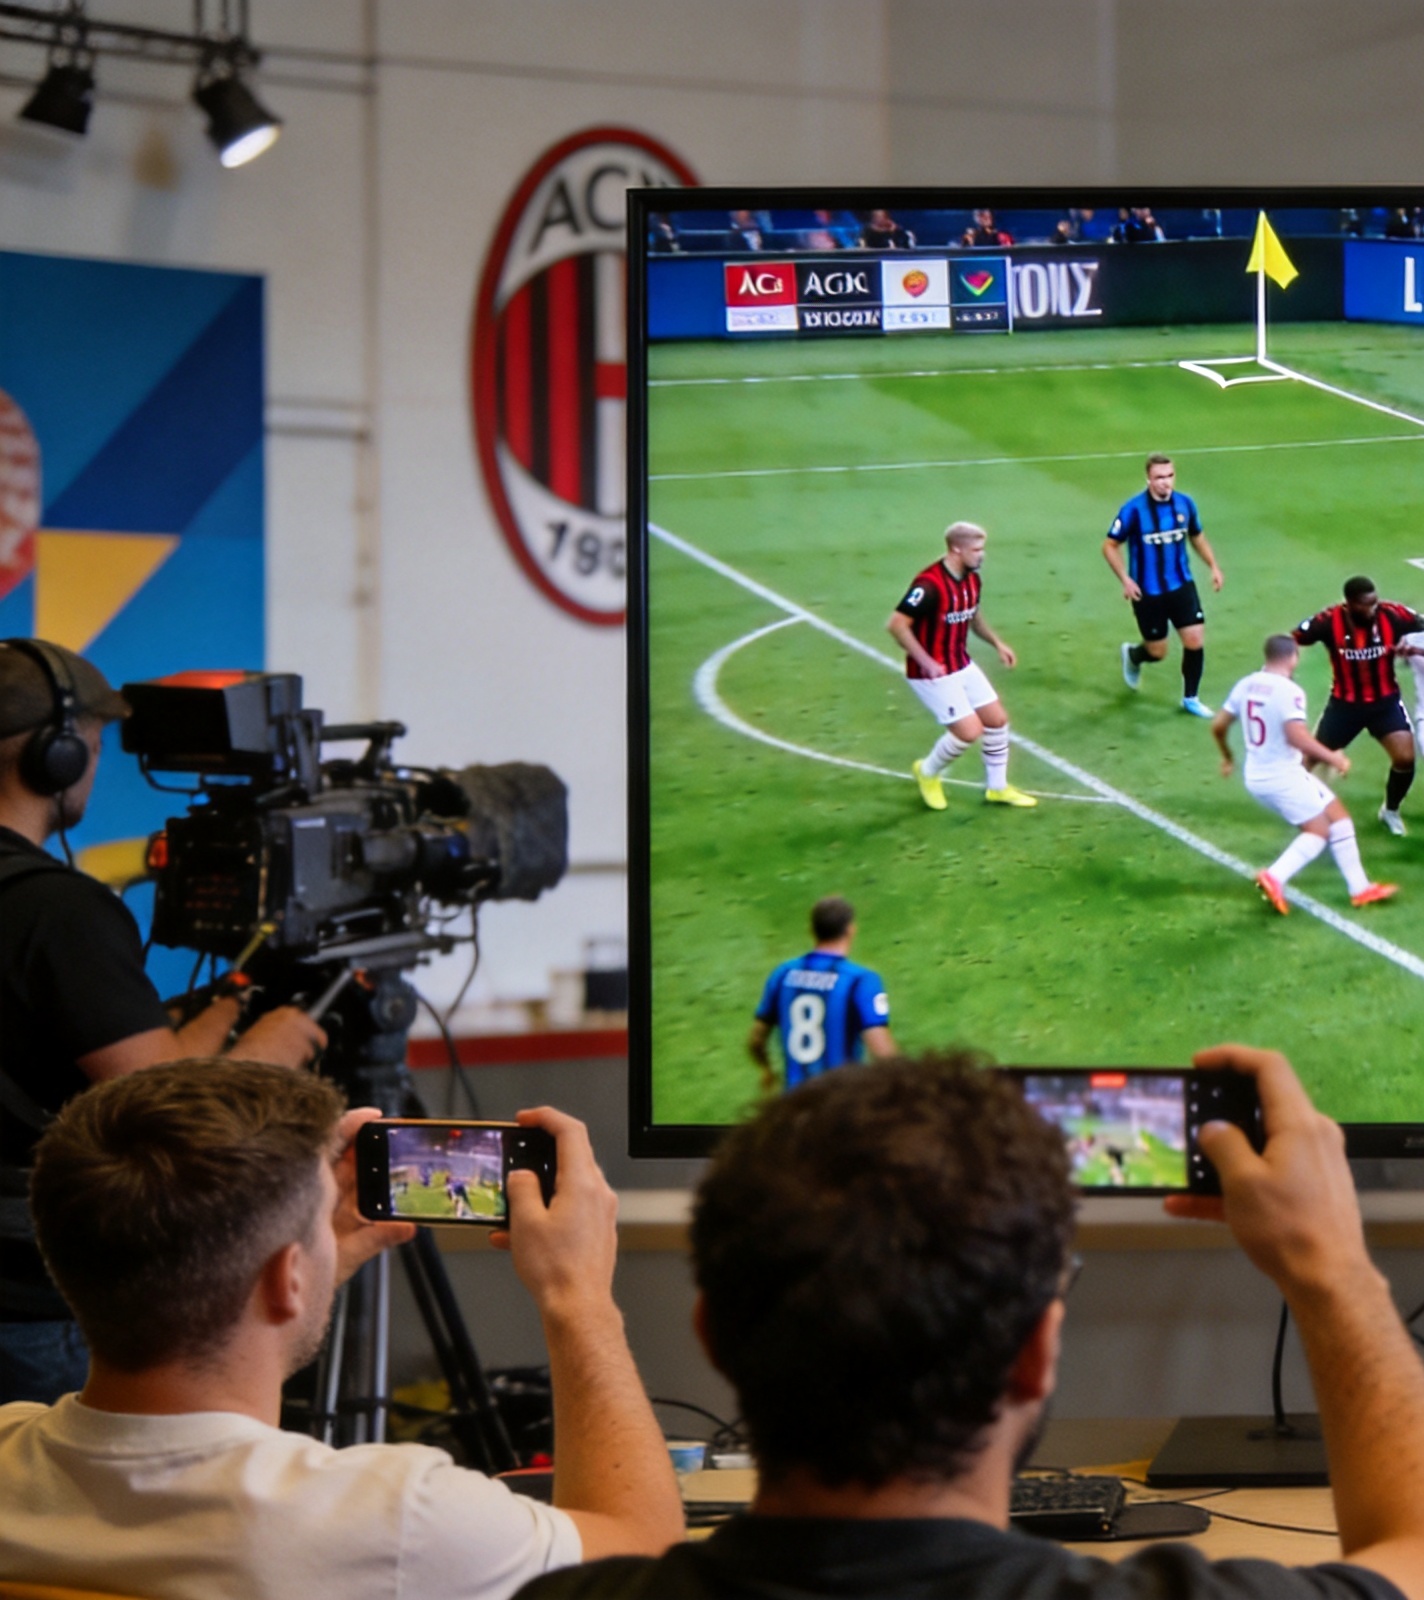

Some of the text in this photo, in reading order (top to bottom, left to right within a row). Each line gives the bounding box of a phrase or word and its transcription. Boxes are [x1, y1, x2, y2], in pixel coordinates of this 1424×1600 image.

[529, 164, 666, 252] AC
[1246, 699, 1267, 747] 5
[787, 993, 826, 1065] 8
